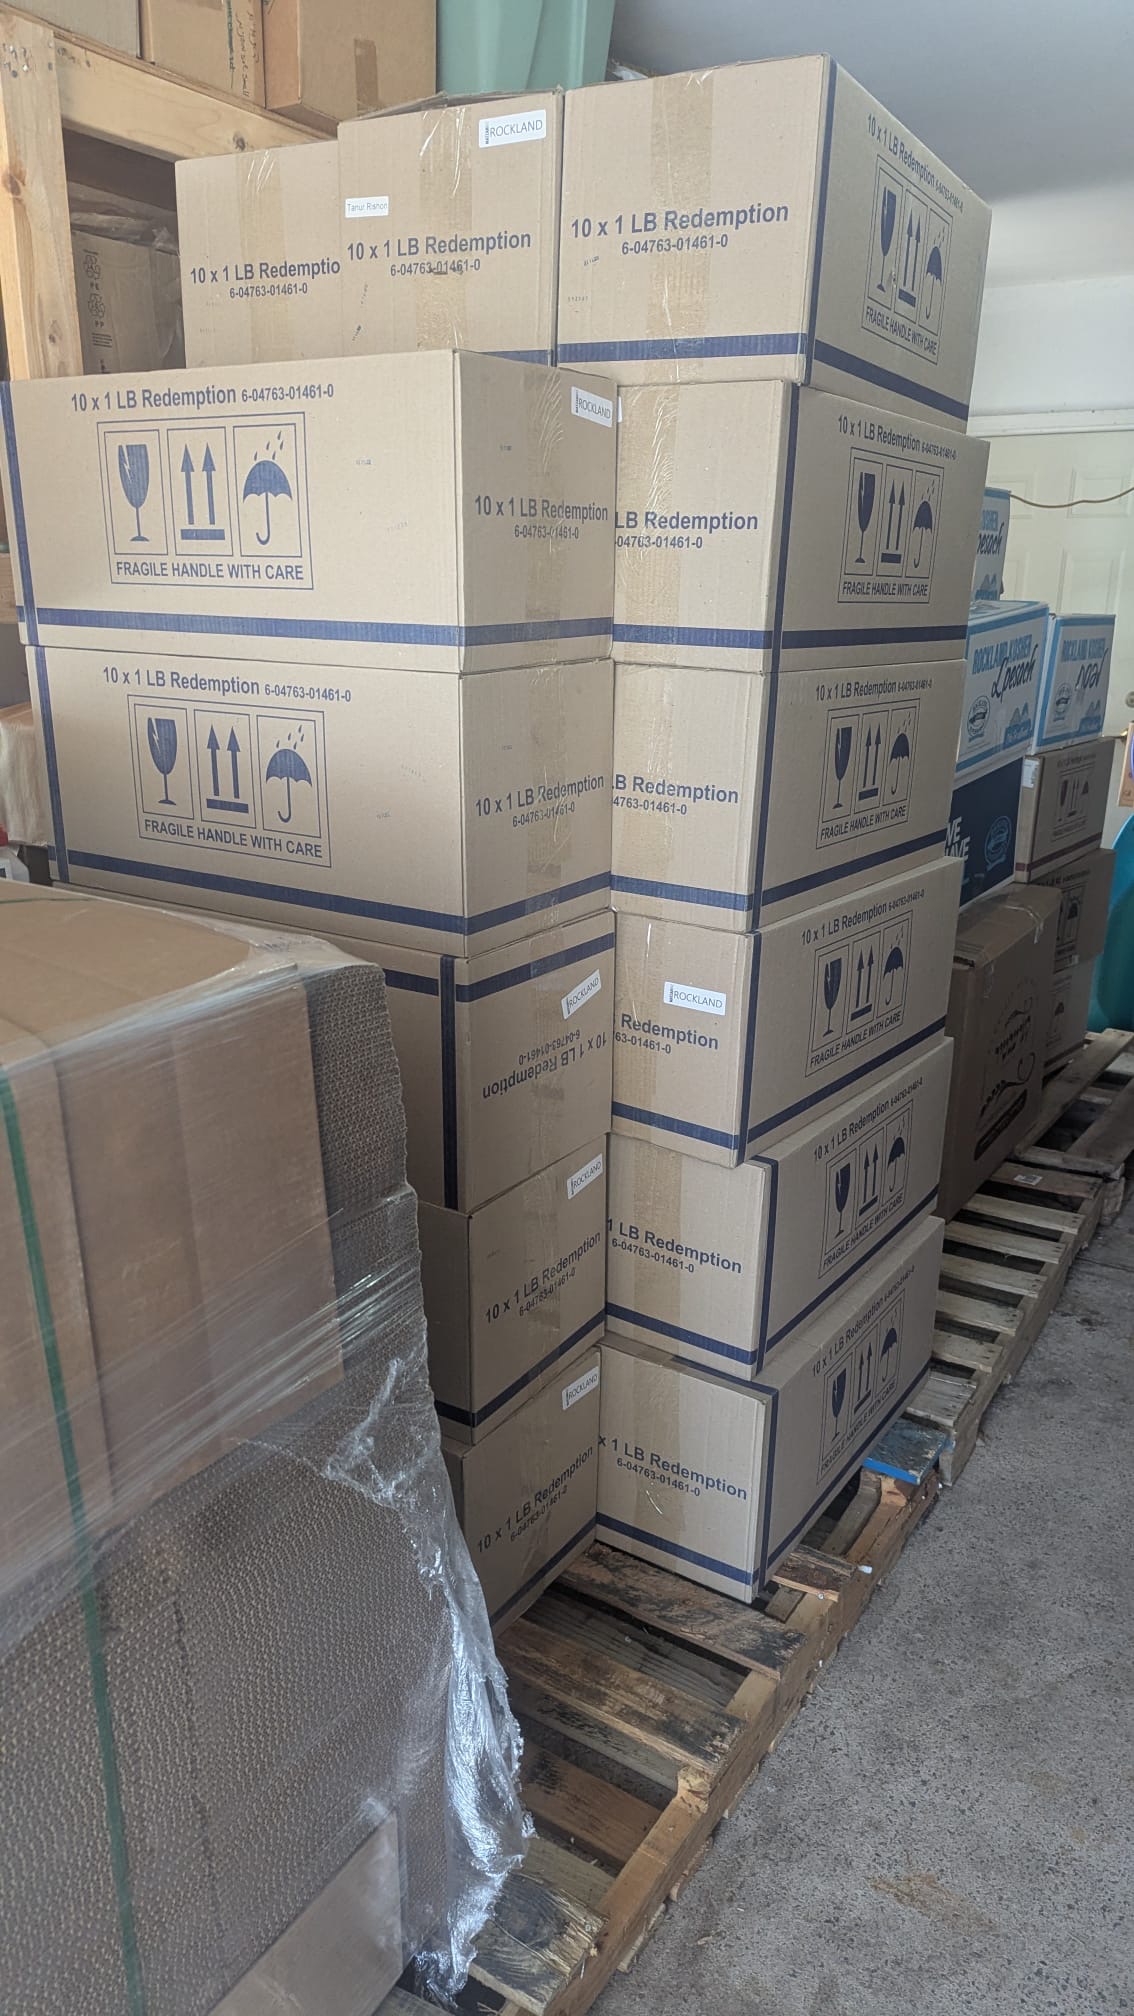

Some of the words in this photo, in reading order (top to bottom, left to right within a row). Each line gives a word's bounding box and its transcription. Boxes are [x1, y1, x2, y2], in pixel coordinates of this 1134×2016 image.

[490, 120, 542, 137] ROCKLAND
[868, 114, 876, 136] 10
[876, 126, 882, 142] x
[883, 128, 887, 146] 1
[889, 132, 898, 156] LB
[900, 142, 934, 188] Redemption
[572, 218, 592, 238] 10
[597, 221, 608, 236] x
[616, 215, 622, 234] 1
[632, 212, 656, 233] LB
[664, 203, 788, 230] Redemption
[348, 242, 364, 260] 10
[370, 245, 378, 259] x
[384, 240, 390, 258] 1
[398, 238, 419, 256] LB
[426, 230, 531, 255] Redemption
[622, 234, 728, 255] 6-04763-01461-0
[190, 267, 206, 284] 10
[210, 270, 218, 283] x
[222, 265, 229, 281] 1
[235, 264, 254, 281] LB
[260, 257, 341, 279] Redemptio
[390, 258, 480, 276] 6-04763-01461-0
[229, 282, 308, 299] 6-04763-01461-0
[866, 306, 889, 331] FRAGILE
[890, 319, 912, 342] HANDLE
[912, 331, 924, 346] WITH
[924, 337, 937, 356] CARE
[72, 392, 87, 412] 10
[92, 396, 100, 410] x
[104, 392, 112, 410] 1
[118, 390, 137, 408] LB
[142, 385, 236, 409] Redemption
[242, 384, 334, 402] 6-04763-01461-0
[578, 398, 610, 418] ROCKLAND
[839, 414, 848, 434] 10
[850, 422, 855, 436] x
[858, 420, 861, 438] 1
[864, 421, 875, 440] LB
[878, 425, 920, 452] Redemption
[475, 496, 492, 516] 10
[496, 501, 504, 516] x
[508, 496, 514, 517] 1
[520, 498, 537, 518] LB
[542, 500, 608, 524] Redemption
[615, 512, 638, 529] LB
[645, 511, 758, 534] Redemption
[614, 536, 702, 548] -04763-01461-0
[117, 562, 168, 577] FRAGILE
[172, 562, 224, 578] HANDLE
[228, 564, 261, 580] WITH
[265, 564, 304, 580] CARE
[842, 581, 870, 595] FRAGILE
[872, 582, 896, 596] HANDLE
[898, 584, 912, 596] WITH
[912, 584, 928, 596] CARE
[972, 641, 1008, 674] ROCKLAND
[104, 666, 118, 684] 10
[122, 671, 130, 685] x
[134, 668, 140, 686] 1
[146, 670, 166, 688] LB
[171, 672, 260, 696] Redemption
[264, 684, 351, 702] 6-04763-01461-0
[816, 684, 825, 701] 10
[826, 688, 832, 700] x
[834, 684, 838, 699] 1
[841, 682, 852, 698] LB
[854, 678, 896, 699] Redemption
[476, 798, 490, 817] 10
[495, 796, 502, 812] x
[506, 792, 512, 810] 1
[518, 788, 534, 808] LB
[538, 774, 604, 803] Redemption
[632, 776, 738, 804] Redemption
[144, 820, 194, 838] FRAGILE
[198, 827, 248, 846] HANDLE
[251, 834, 282, 851] WITH
[286, 840, 322, 858] CARE
[820, 822, 848, 840] FRAGILE
[850, 815, 874, 832] HANDLE
[875, 810, 890, 824] WITH
[890, 805, 906, 820] CARE
[802, 929, 811, 946] 10
[813, 930, 818, 942] x
[820, 924, 825, 938] 1
[828, 918, 840, 936] LB
[842, 902, 887, 930] Redemption
[569, 976, 600, 1010] ROCKLAND
[673, 990, 723, 1009] ROCKLAND
[518, 1029, 581, 1066] 6-04763-01461-0
[588, 1037, 594, 1050] x
[596, 1031, 608, 1049] 10
[622, 1013, 719, 1050] Redemption
[810, 1044, 840, 1068] FRAGILE
[842, 1028, 868, 1052] HANDLE
[868, 1022, 884, 1036] WITH
[884, 1010, 902, 1028] CARE
[560, 1047, 577, 1068] LB
[579, 1042, 585, 1058] 1
[482, 1058, 558, 1099] Redemption
[814, 1144, 822, 1160] 10
[824, 1144, 830, 1156] x
[831, 1136, 834, 1150] 1
[837, 1128, 847, 1146] LB
[848, 1100, 890, 1138] Redemption
[574, 1161, 602, 1190] ROCKLAND
[612, 1238, 695, 1274] 6-04763-01461-0
[620, 1222, 640, 1240] LB
[644, 1230, 742, 1274] Redemption
[485, 1307, 500, 1324] 10
[503, 1298, 510, 1313] x
[514, 1288, 520, 1305] 1
[524, 1277, 538, 1298] LB
[542, 1231, 600, 1285] Redemption
[813, 1364, 820, 1376] 10
[822, 1356, 828, 1368] x
[829, 1347, 832, 1360] 1
[834, 1337, 844, 1355] LB
[846, 1298, 884, 1344] Redemption
[568, 1374, 598, 1400] ROCKLAND
[598, 1435, 606, 1447] x
[612, 1438, 618, 1452] 1
[624, 1442, 644, 1462] LB
[650, 1452, 747, 1500] Redemption
[616, 1458, 700, 1497] 6-04763-01461-0
[478, 1534, 492, 1552] 10
[494, 1528, 502, 1542] x
[506, 1514, 512, 1530] 1
[516, 1501, 531, 1522] LB
[534, 1446, 593, 1506] Redemption
